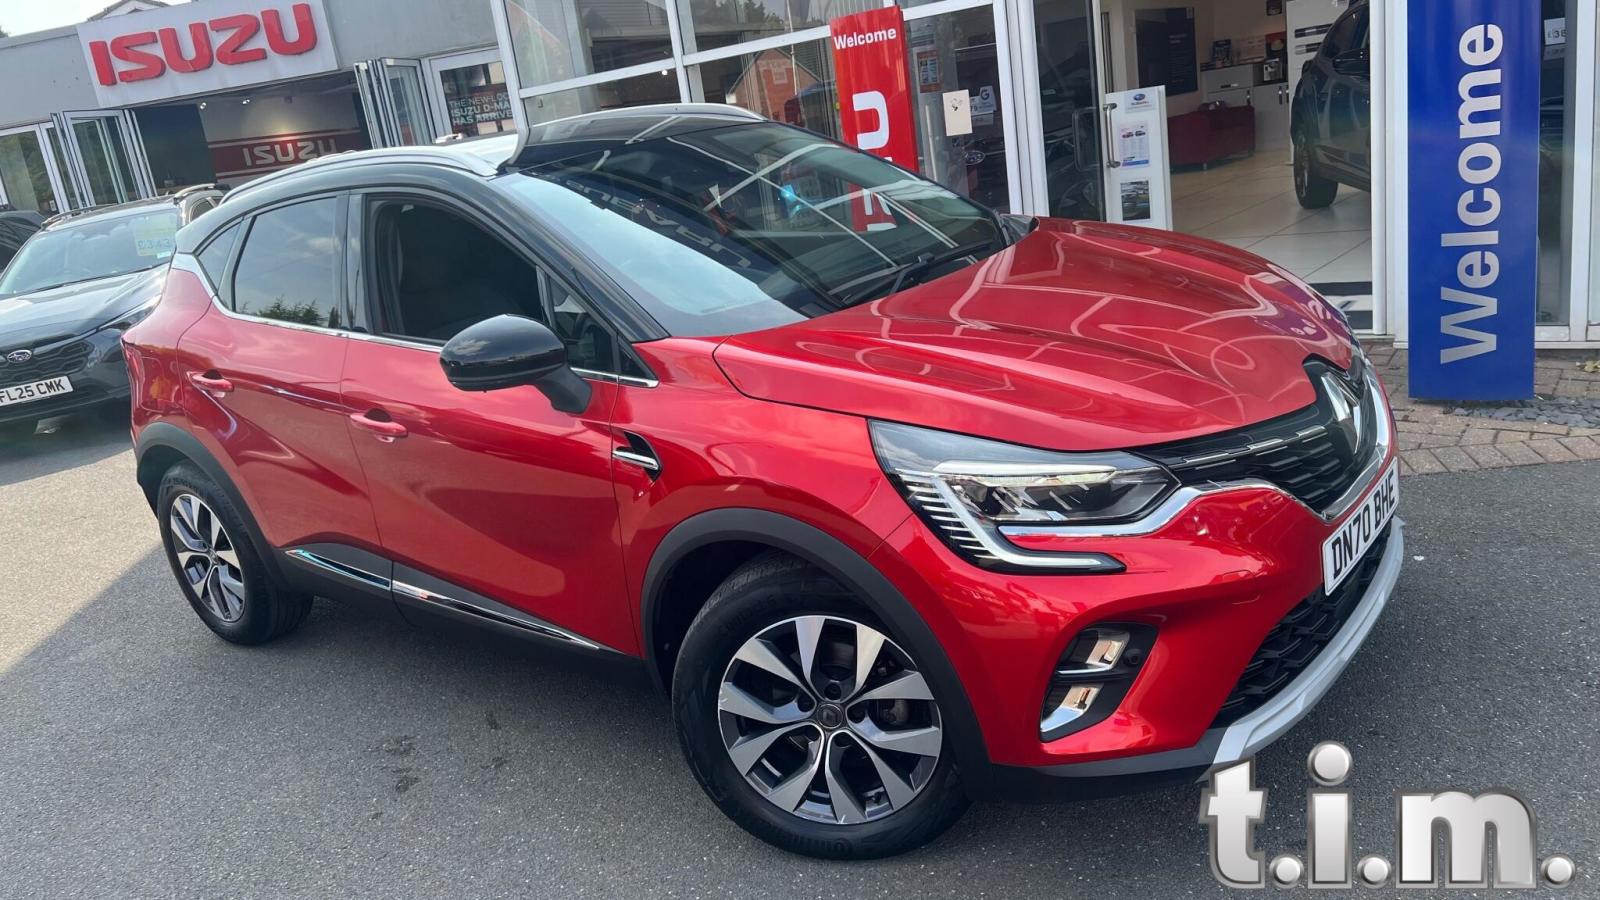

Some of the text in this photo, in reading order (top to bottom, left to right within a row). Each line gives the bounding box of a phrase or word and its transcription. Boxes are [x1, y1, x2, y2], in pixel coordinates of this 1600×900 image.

[89, 4, 317, 86] ISUZU
[834, 28, 897, 50] Welcome
[451, 100, 511, 118] ISUZU D-MA
[452, 109, 513, 126] HAS ARRIVE
[242, 138, 337, 167] ISUZU
[1440, 23, 1503, 364] Welcome
[0, 379, 66, 403] FL25 CMK
[1332, 468, 1395, 580] DN70 BHE
